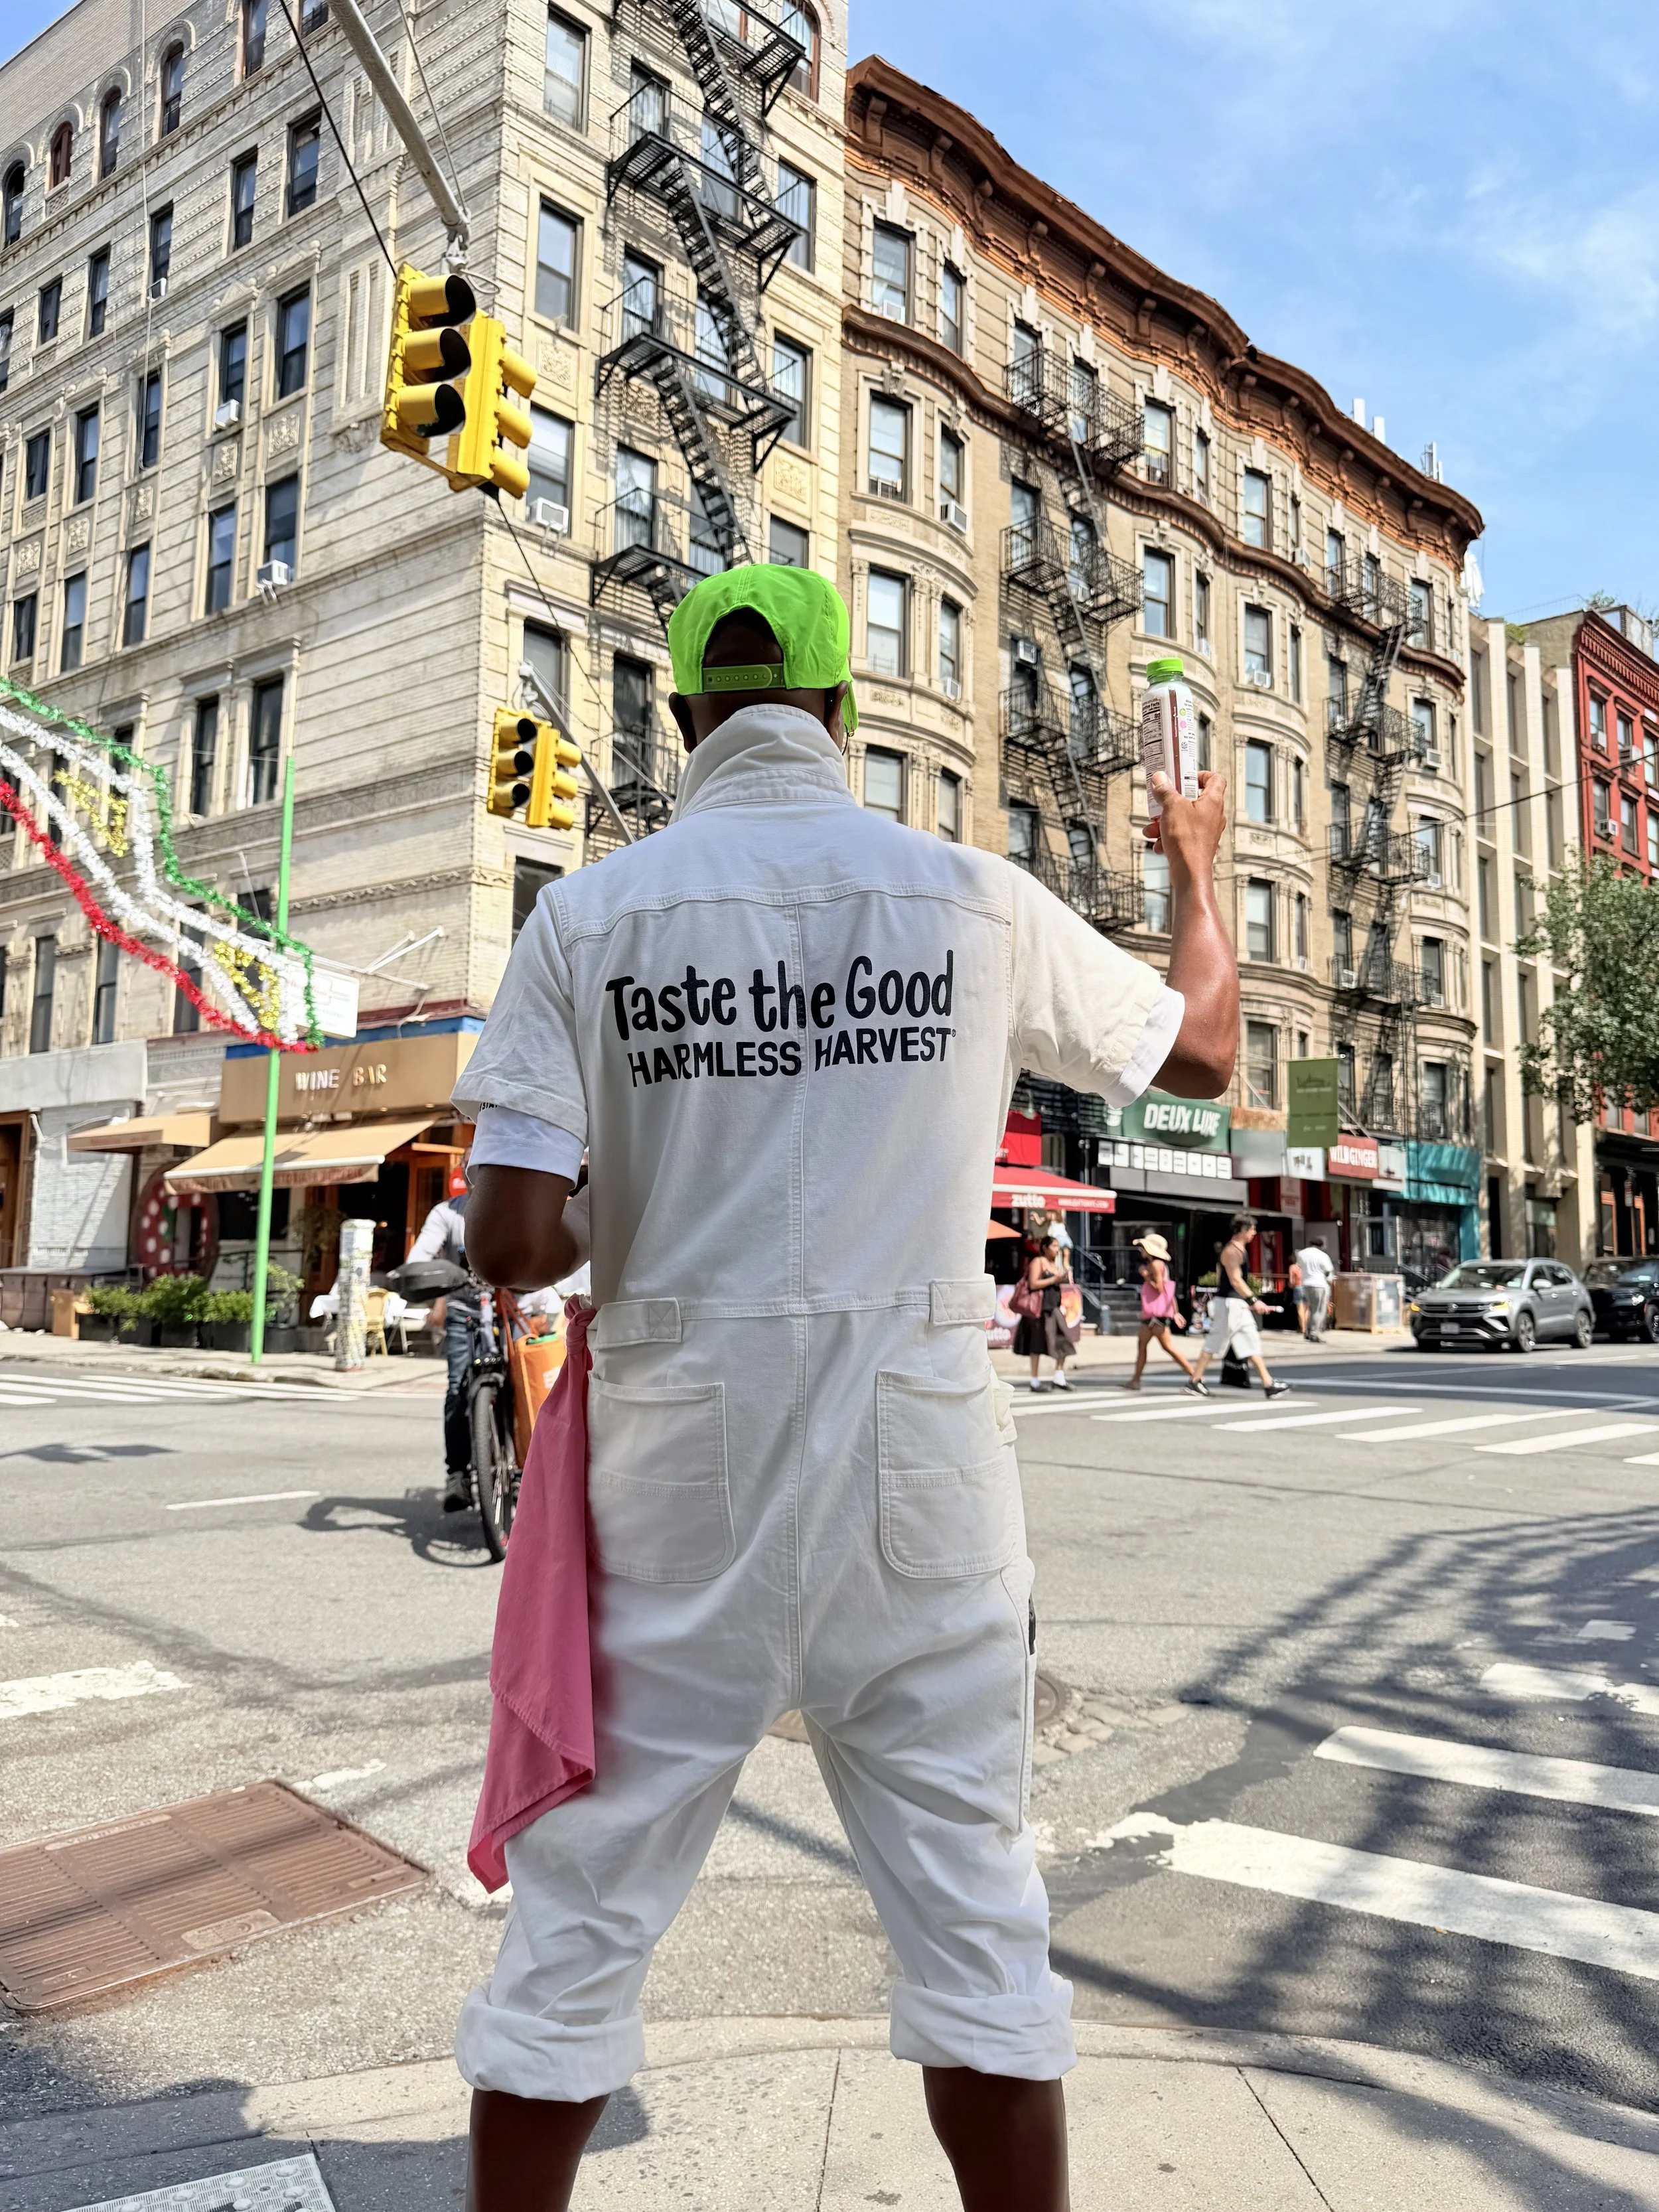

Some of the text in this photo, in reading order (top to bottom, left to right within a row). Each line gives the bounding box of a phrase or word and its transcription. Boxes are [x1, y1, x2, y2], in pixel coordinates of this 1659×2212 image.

[605, 950, 953, 1041] Taste the Good
[627, 1041, 802, 1087] HARMLESS
[295, 1069, 340, 1091] WINE
[1143, 1103, 1222, 1138] DEUX LUXE
[1329, 1145, 1350, 1164] WILD
[1350, 1148, 1378, 1169] GINGER
[986, 1327, 1011, 1341] utto
